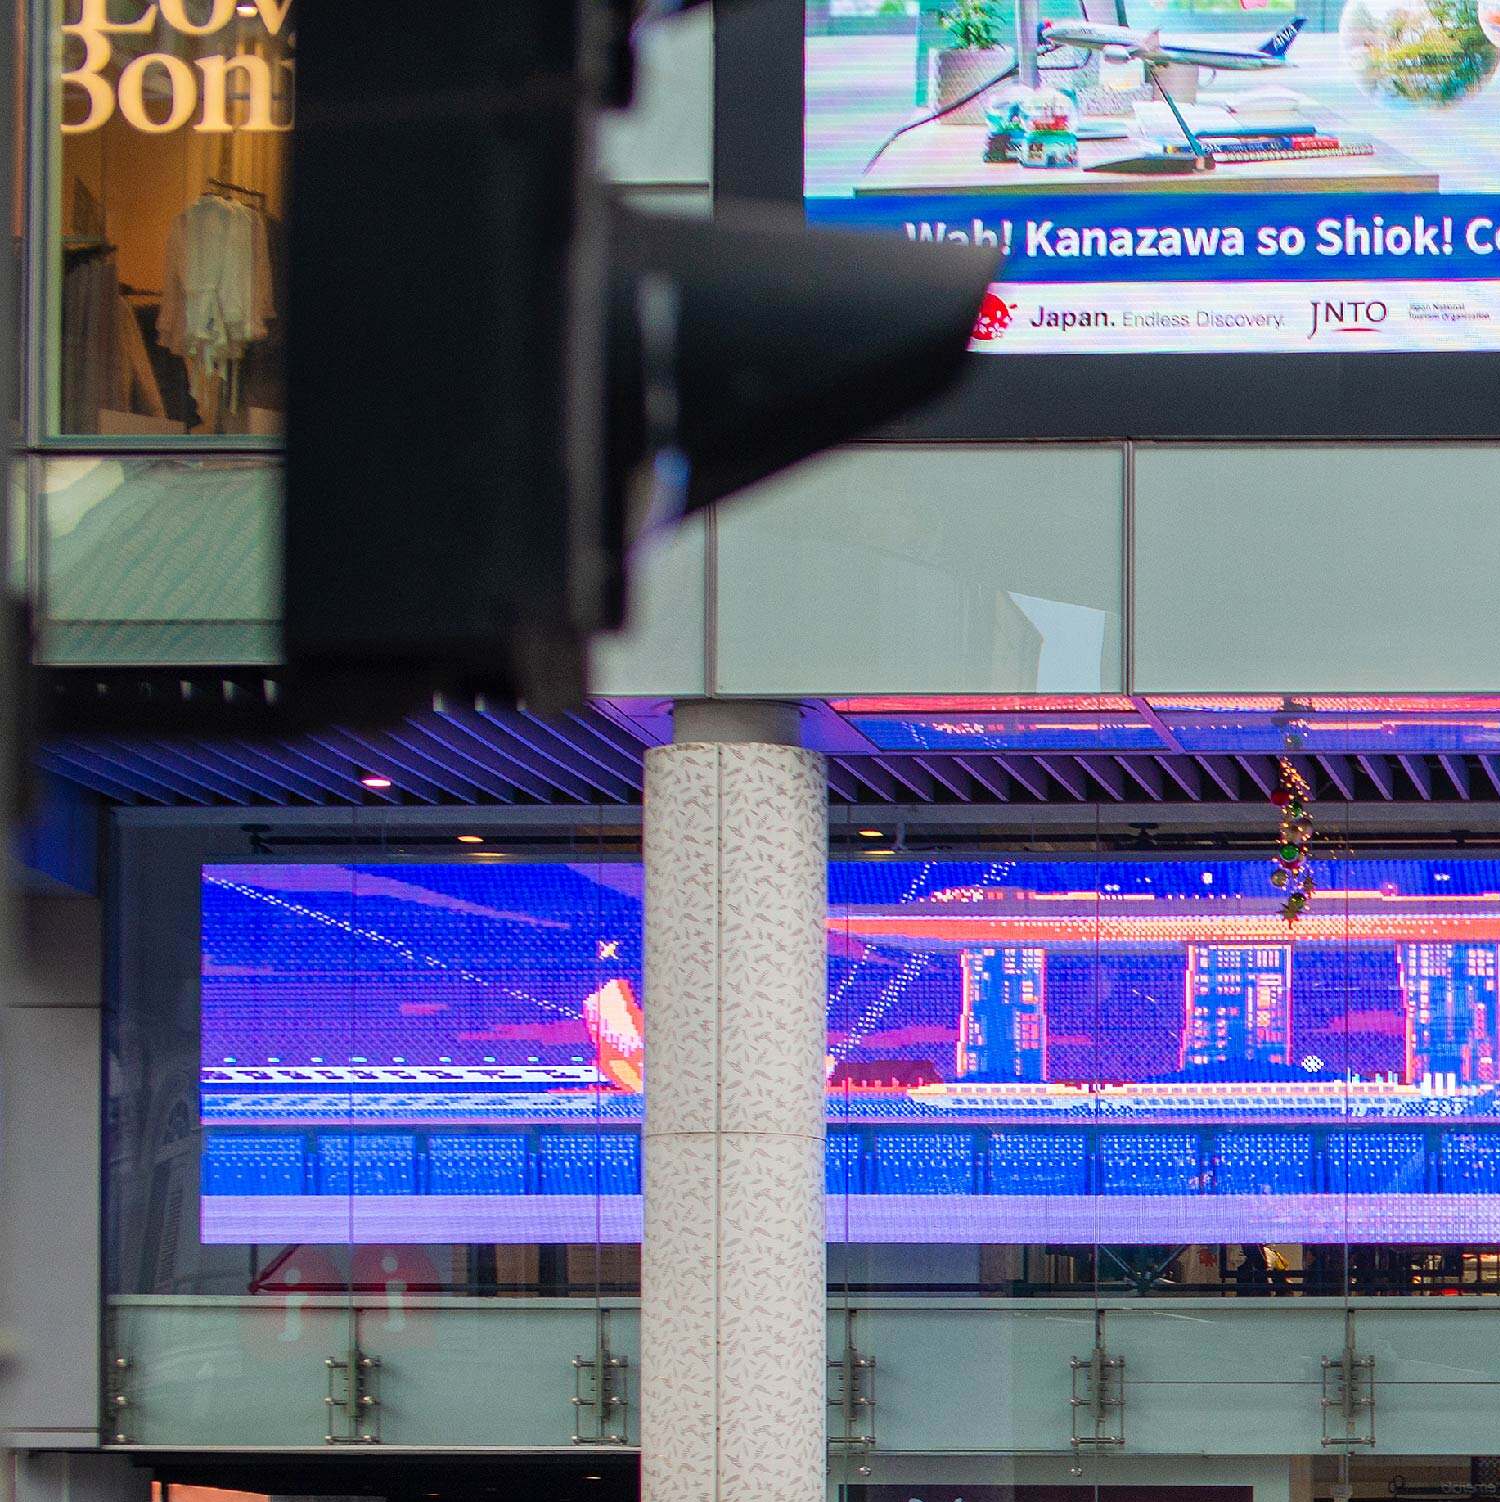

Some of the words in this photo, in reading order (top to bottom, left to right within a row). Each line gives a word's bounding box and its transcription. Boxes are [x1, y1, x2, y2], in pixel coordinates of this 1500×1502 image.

[1026, 220, 1245, 257] Kanazawa
[1257, 229, 1306, 257] so
[1316, 215, 1453, 257] Shiok!
[1030, 305, 1116, 332] Japan.
[1123, 310, 1190, 328] Endless
[1306, 300, 1388, 341] JNTO
